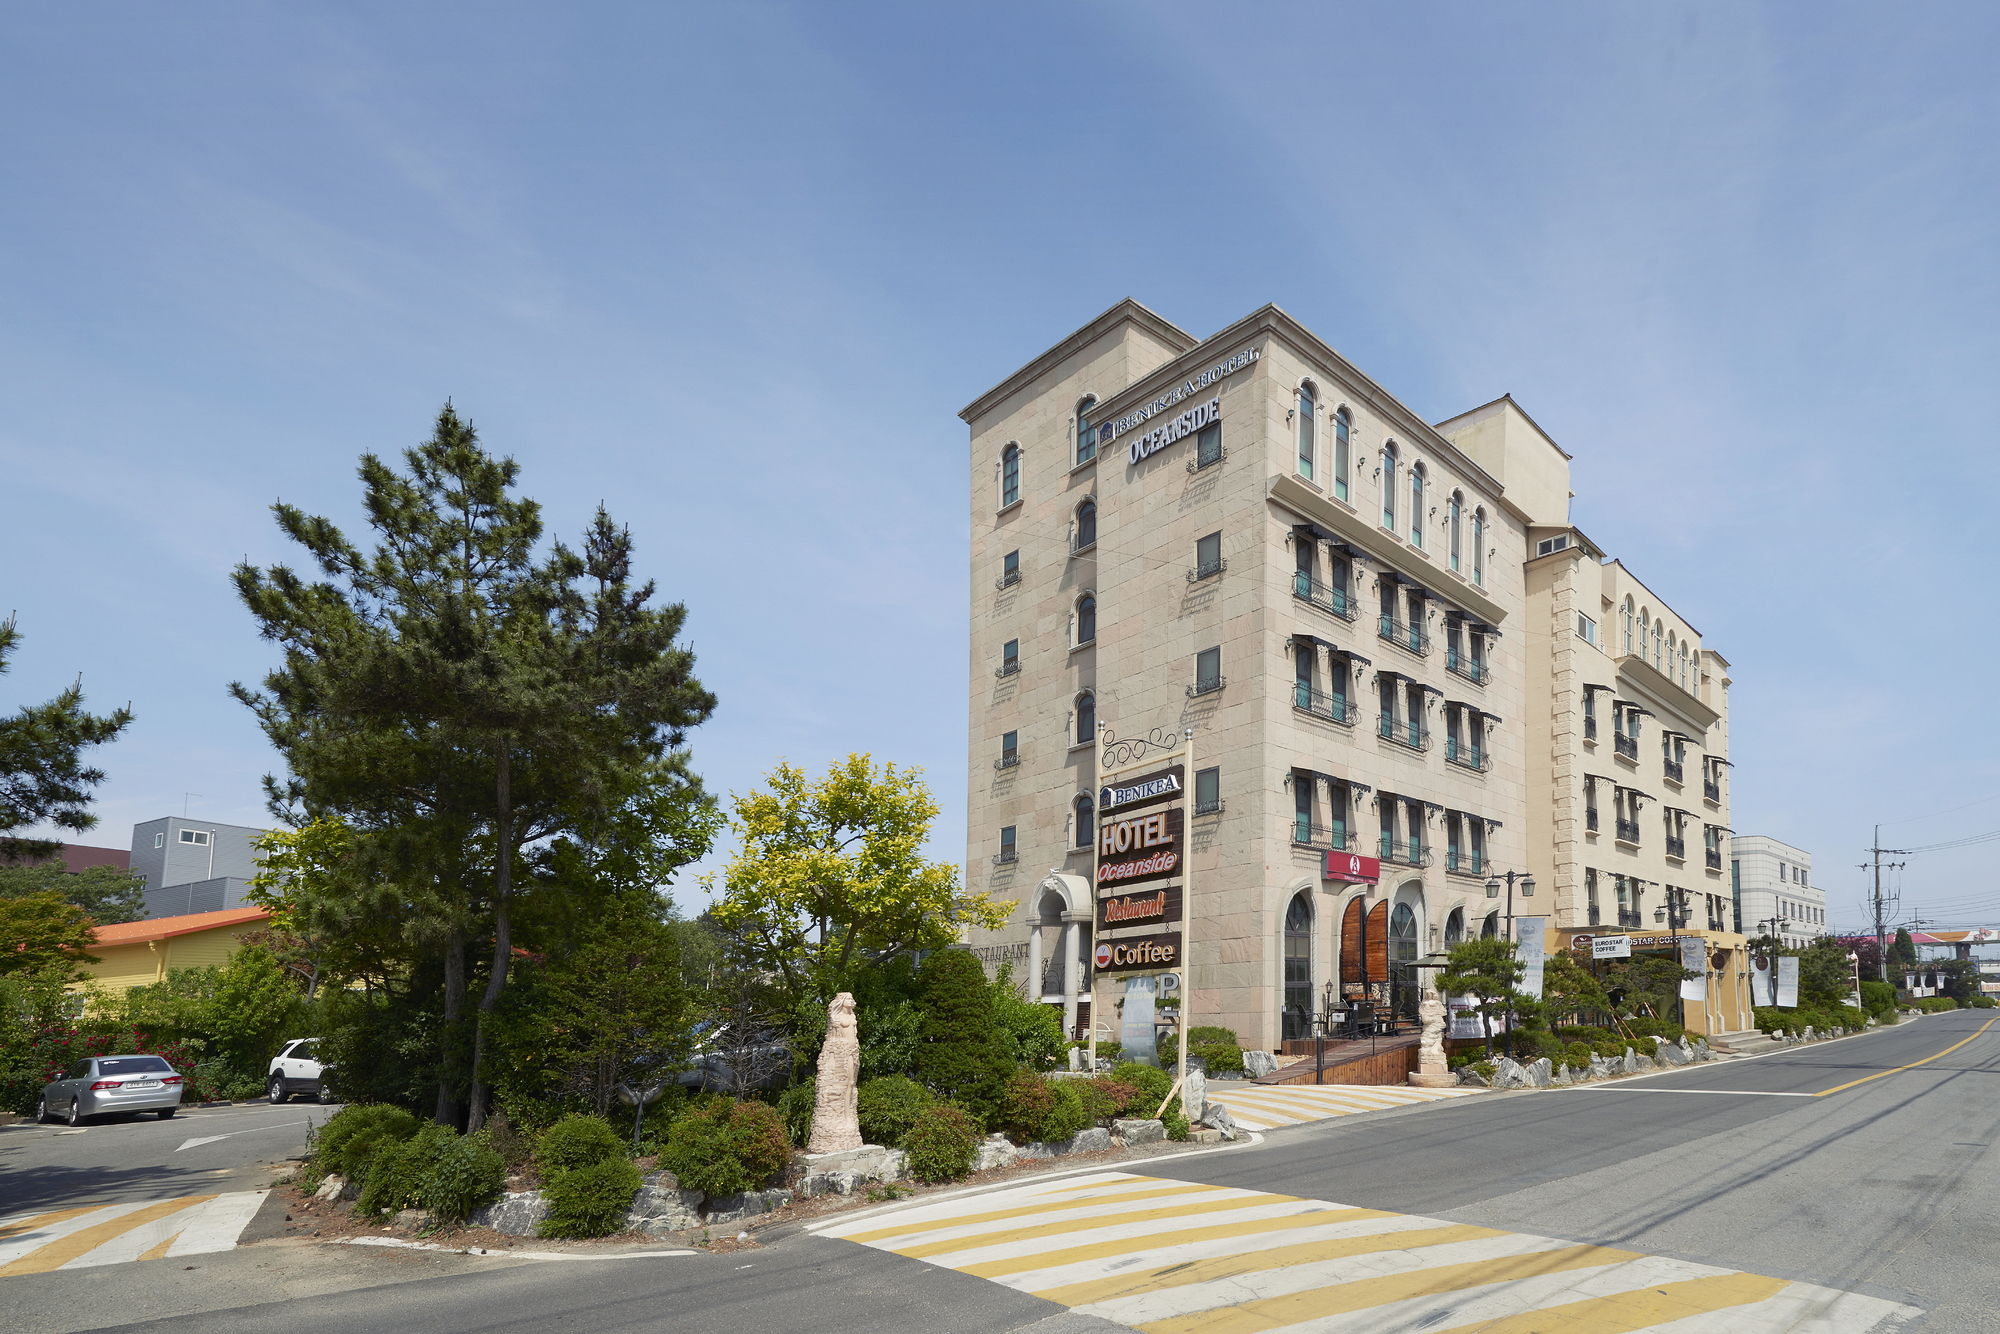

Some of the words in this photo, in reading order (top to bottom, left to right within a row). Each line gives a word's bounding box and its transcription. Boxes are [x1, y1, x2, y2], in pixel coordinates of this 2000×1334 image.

[1116, 380, 1197, 434] BENIKEA
[1198, 347, 1259, 388] HOTEL
[1129, 397, 1220, 465] OCEANSIDE
[1115, 774, 1178, 804] BENIKEA
[1101, 813, 1173, 856] HOTEL
[1097, 851, 1177, 882] Oceanside
[1105, 891, 1166, 922] Restaurant
[1114, 941, 1175, 965] Coffee
[1595, 939, 1623, 947] EUROSTAR
[1160, 973, 1180, 999] P
